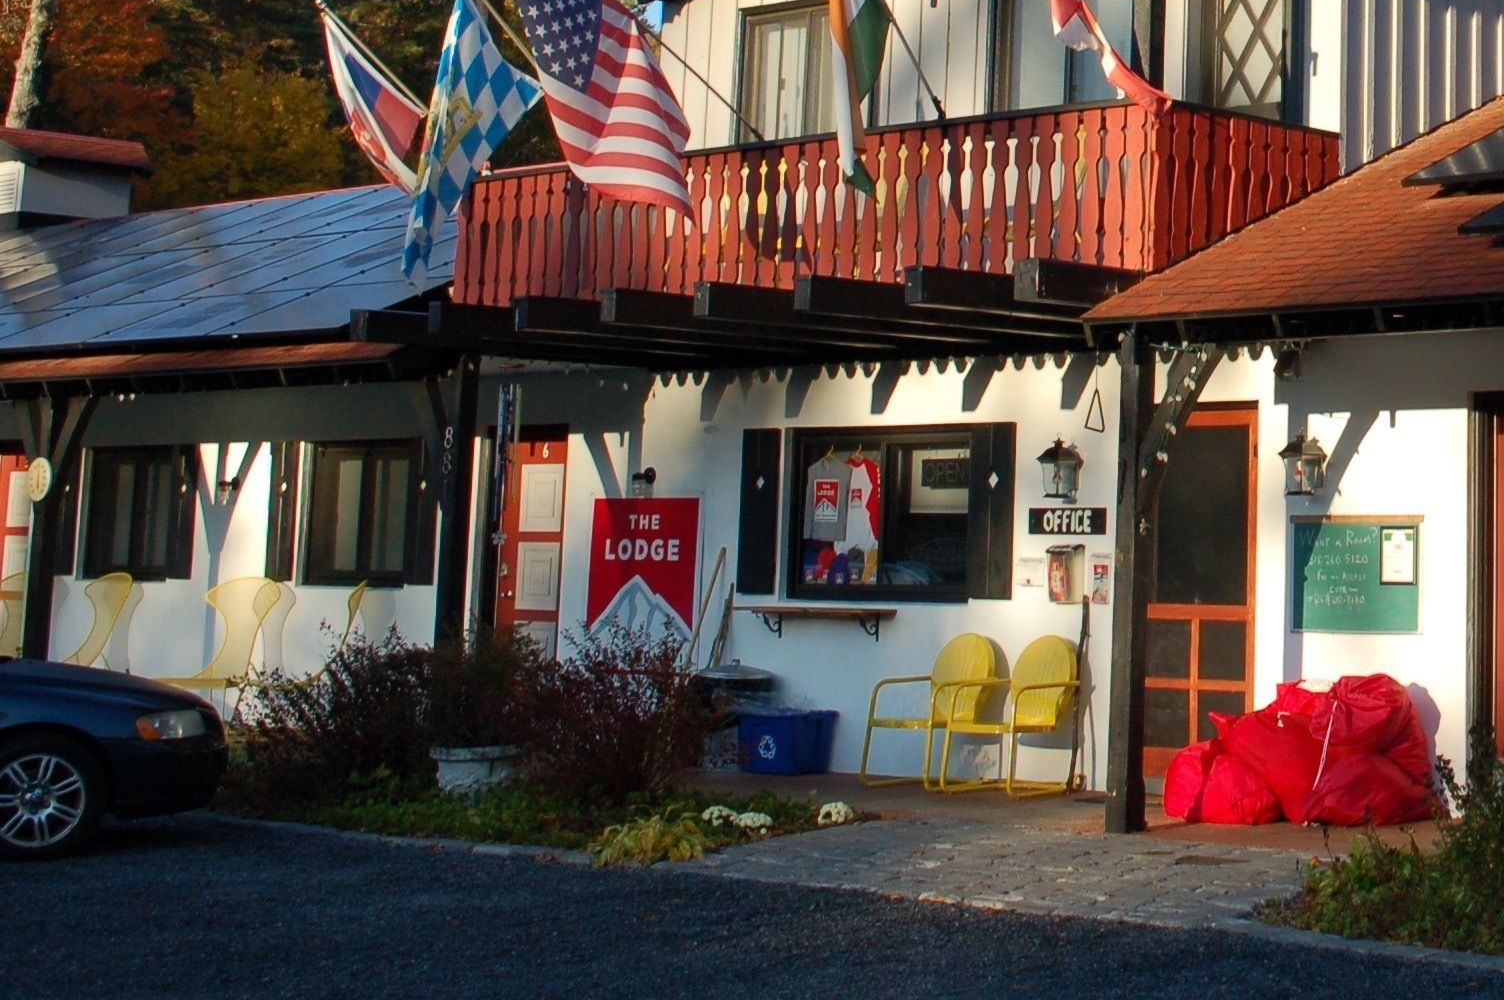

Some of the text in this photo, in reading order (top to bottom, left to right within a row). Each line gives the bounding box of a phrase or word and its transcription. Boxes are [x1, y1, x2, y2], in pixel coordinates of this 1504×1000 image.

[542, 441, 550, 459] 6
[924, 462, 966, 483] OPEN
[629, 514, 661, 530] THE
[1043, 509, 1092, 533] OFFICE
[604, 538, 680, 562] LODGE
